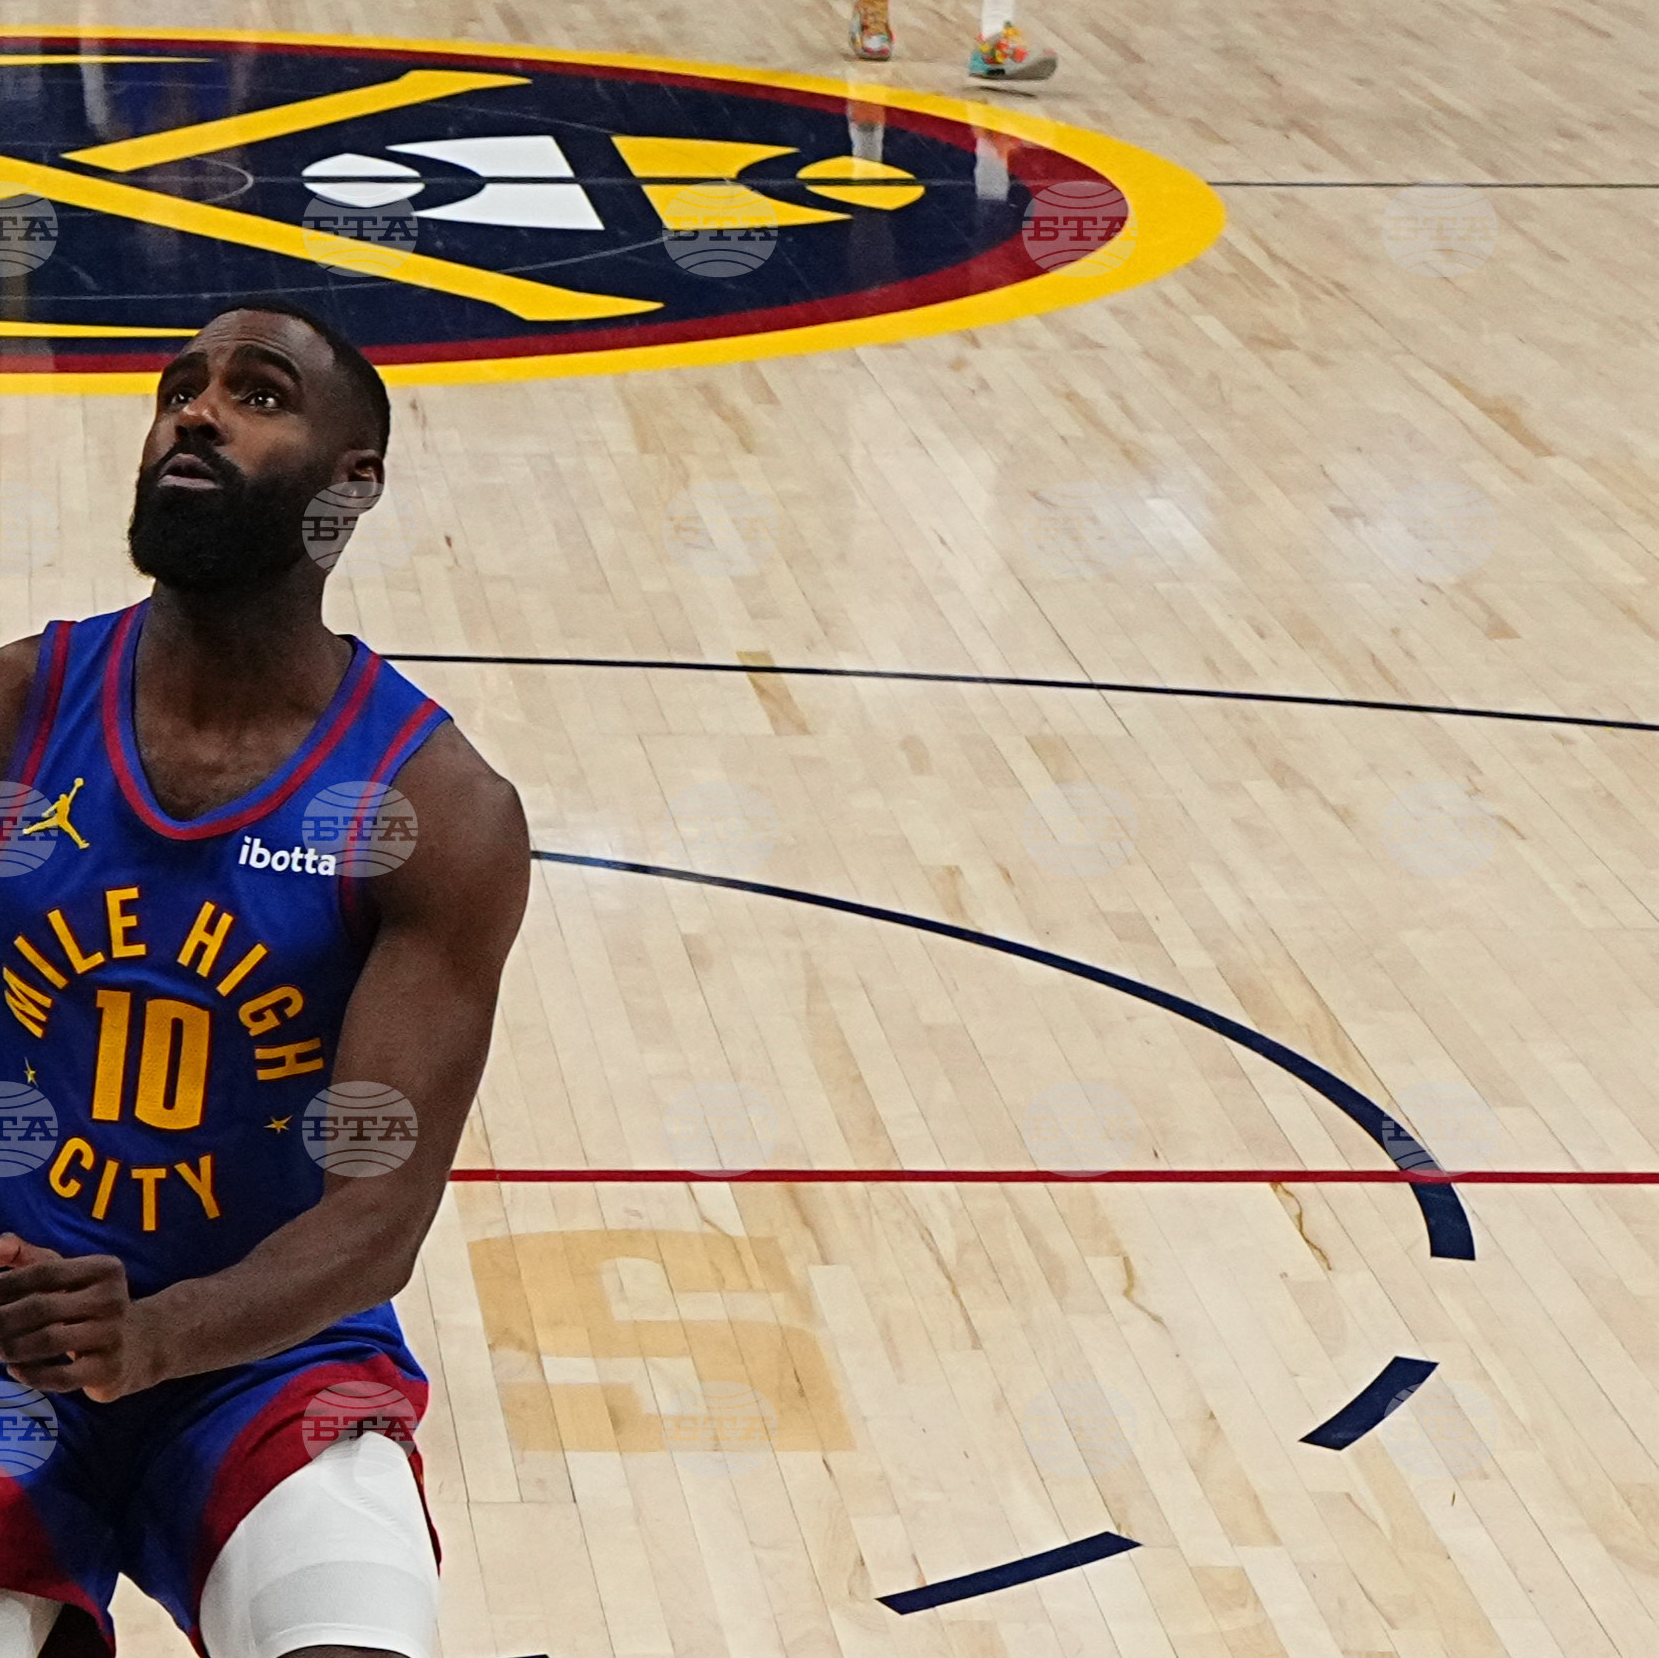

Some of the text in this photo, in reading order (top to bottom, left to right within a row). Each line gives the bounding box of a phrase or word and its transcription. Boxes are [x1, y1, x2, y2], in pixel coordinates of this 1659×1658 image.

[238, 835, 337, 877] ibotta
[2, 886, 326, 1081] MILE HIGH
[91, 988, 211, 1131] 10
[48, 1136, 221, 1232] CITY
